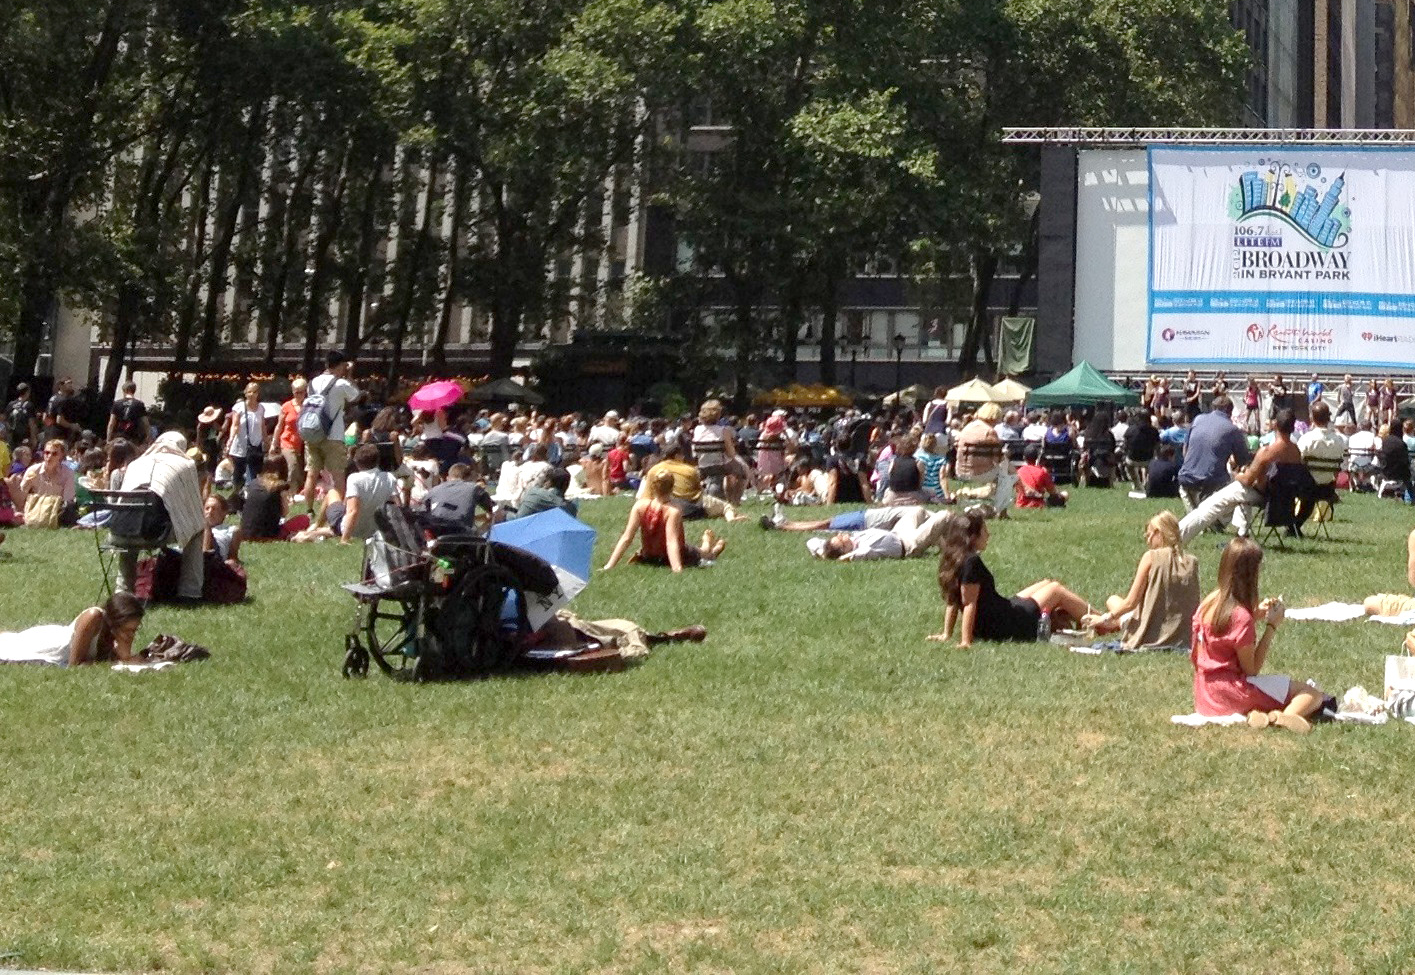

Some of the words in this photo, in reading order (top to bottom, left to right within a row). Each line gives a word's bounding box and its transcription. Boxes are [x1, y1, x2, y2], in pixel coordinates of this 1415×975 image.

[1234, 226, 1264, 236] 106.7
[1242, 251, 1351, 269] BROADWAY
[1241, 269, 1255, 279] IN
[1259, 270, 1312, 280] BRYANT
[1315, 271, 1351, 280] PARK
